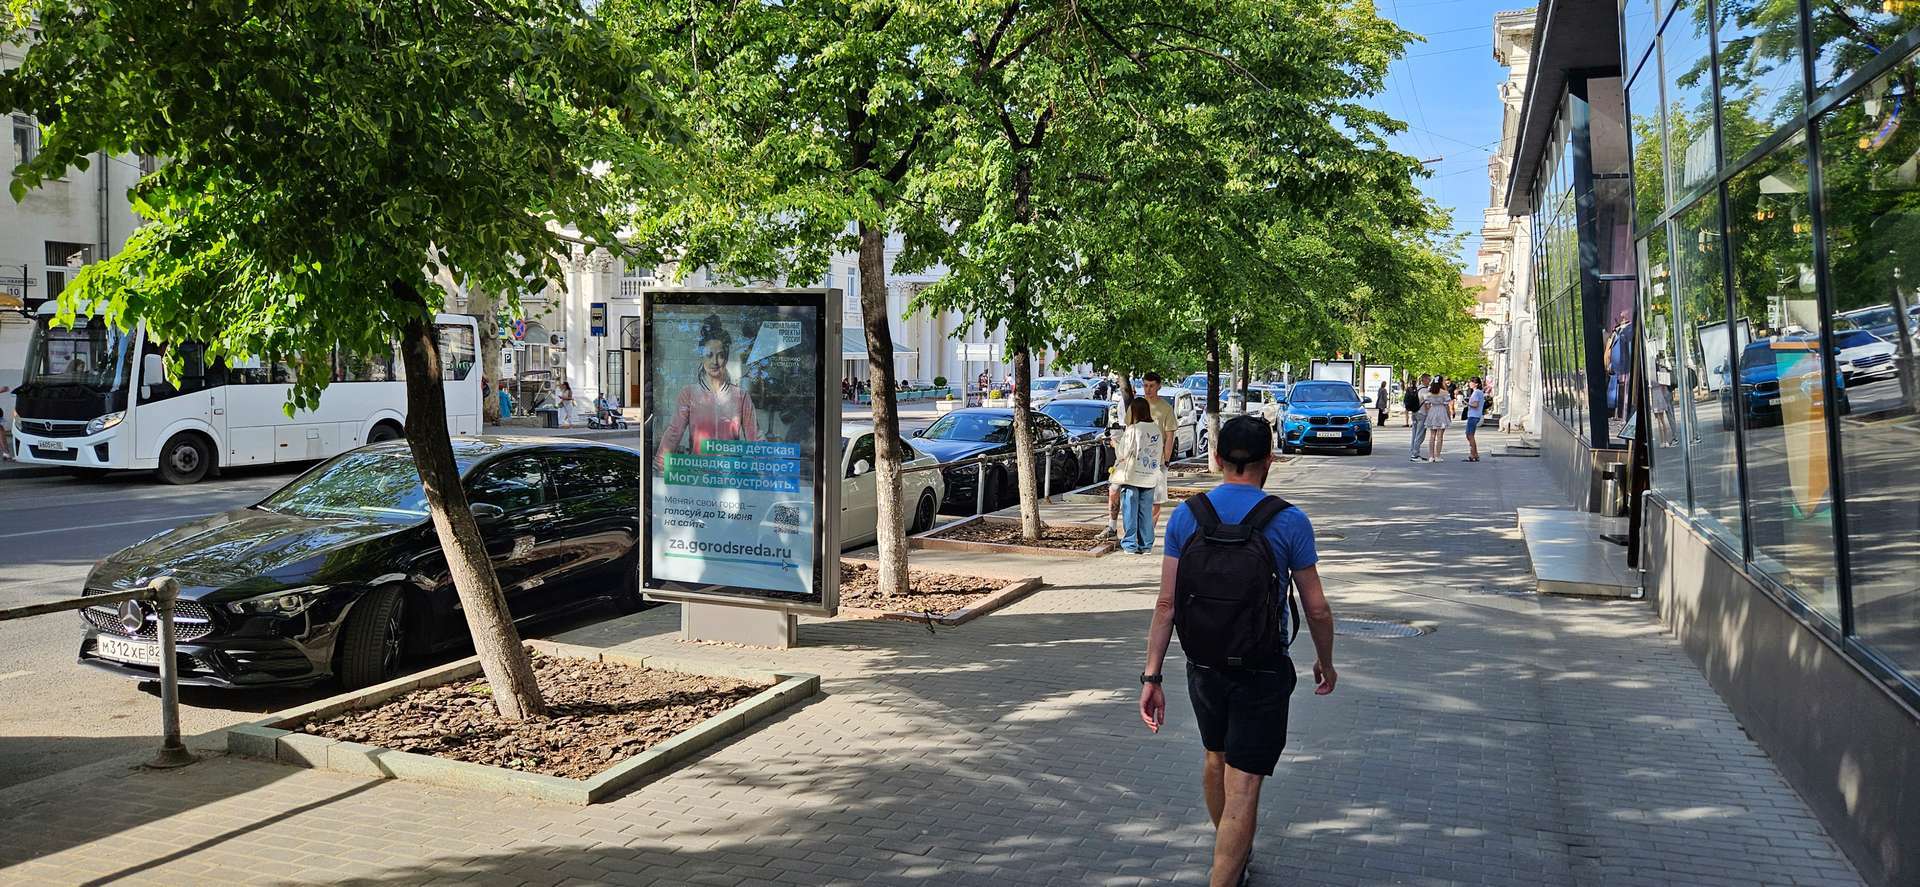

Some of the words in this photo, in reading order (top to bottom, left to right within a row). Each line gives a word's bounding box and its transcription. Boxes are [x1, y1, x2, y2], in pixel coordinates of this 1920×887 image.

[9, 288, 19, 296] 10
[706, 441, 743, 453] Новая
[745, 444, 795, 456] детская
[669, 456, 730, 470] площадка
[734, 460, 748, 470] во
[750, 462, 794, 474] дворе?
[668, 472, 699, 485] Могу
[702, 474, 795, 490] благоустроить.
[664, 495, 694, 505] Меняй
[696, 498, 717, 507] свой
[664, 507, 702, 518] голосуй
[703, 511, 715, 519] до
[717, 510, 726, 519] 12
[727, 513, 753, 521] июня
[664, 518, 676, 527] на
[678, 518, 705, 528] сайте
[669, 537, 792, 559] za.gorodsreda.ru
[102, 640, 146, 660] М312ХЕ
[148, 645, 160, 657] 82
